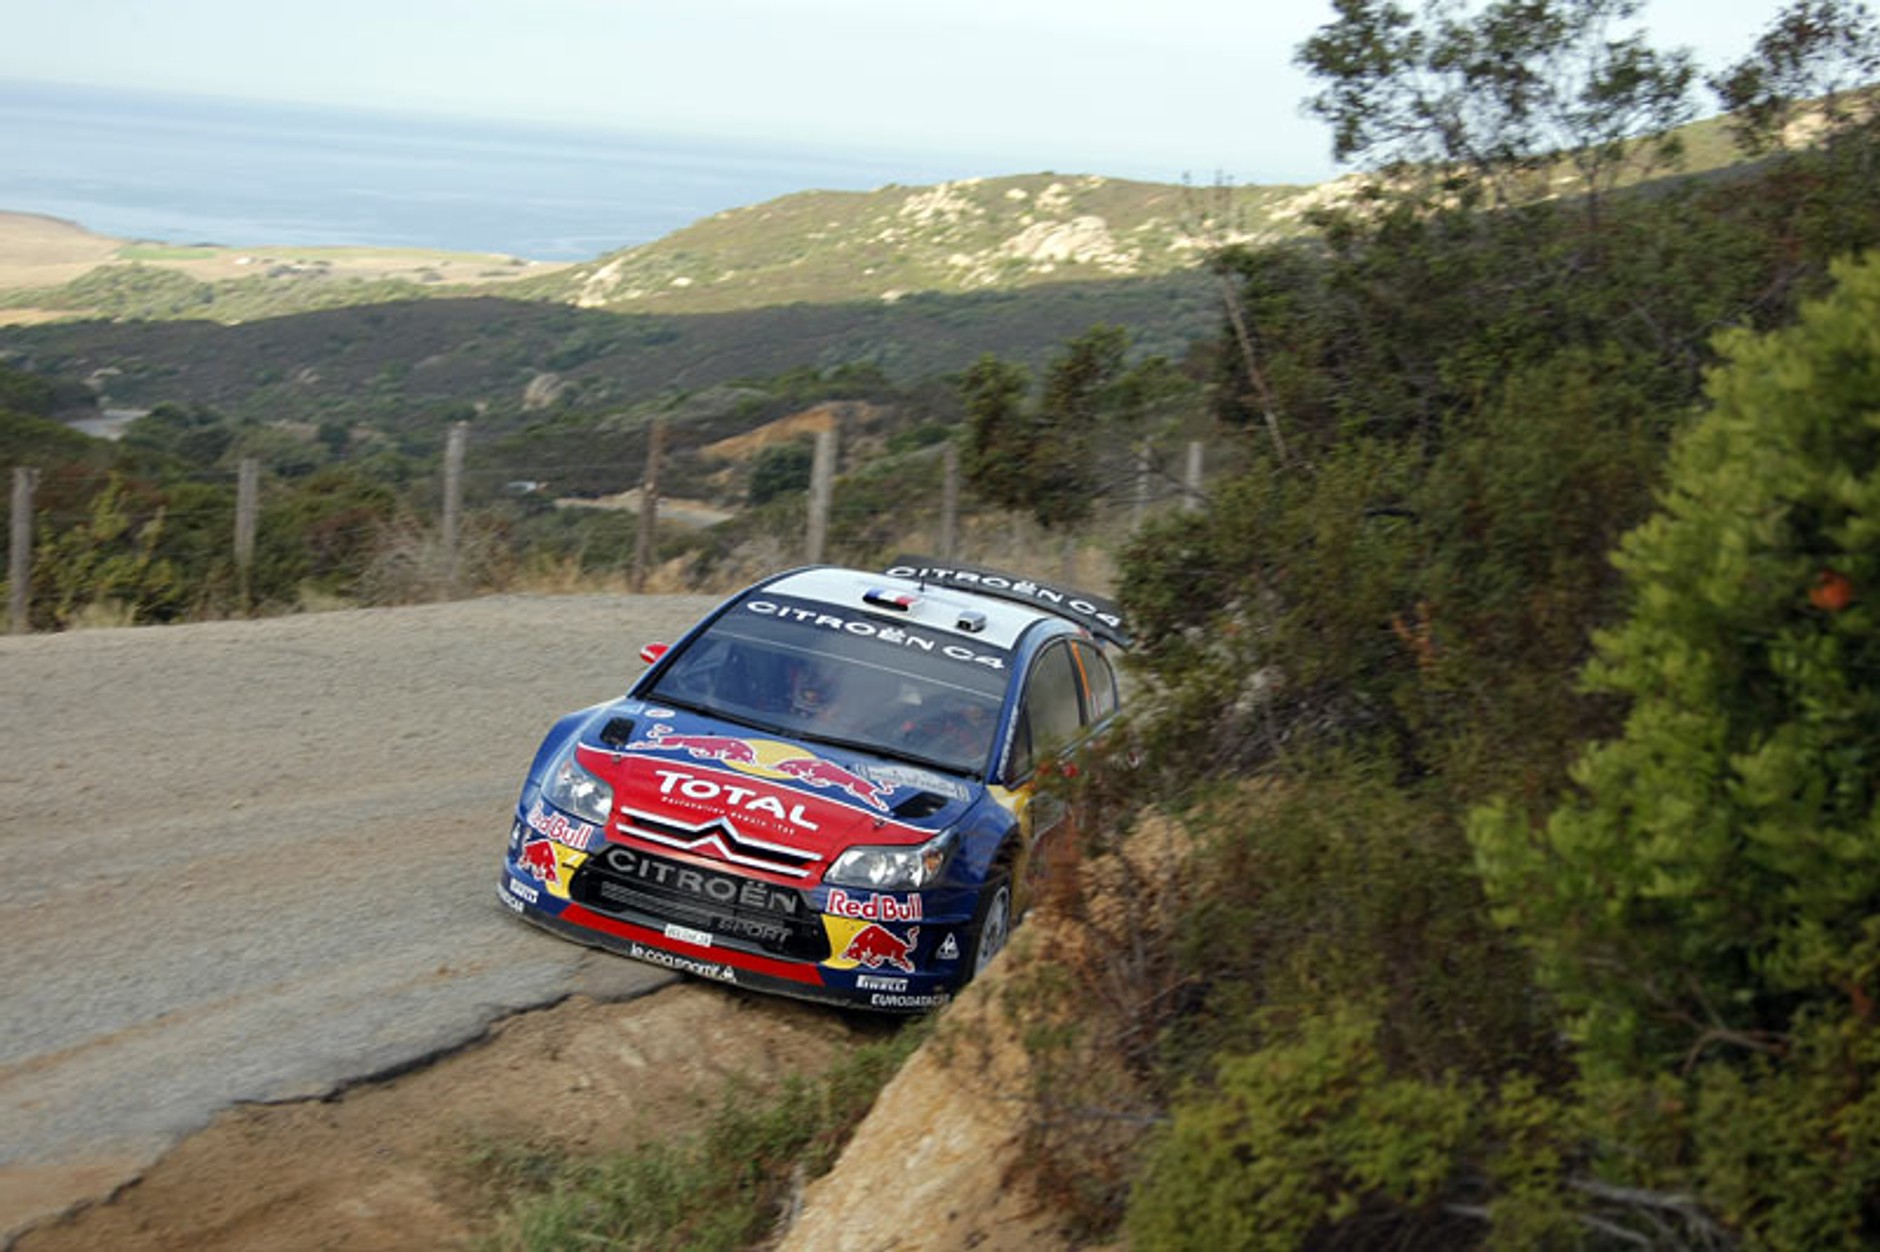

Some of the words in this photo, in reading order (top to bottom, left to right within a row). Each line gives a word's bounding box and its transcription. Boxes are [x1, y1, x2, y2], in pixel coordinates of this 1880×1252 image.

[886, 566, 1064, 603] CITROËN
[1069, 600, 1121, 627] C4
[747, 601, 935, 650] CITROËN
[942, 645, 1005, 669] C4
[655, 769, 819, 831] TOTAL
[549, 812, 594, 851] Bull
[606, 849, 798, 914] CITROËN
[825, 888, 879, 919] Red
[880, 892, 922, 921] Bull
[719, 916, 793, 944] SPORT
[856, 974, 909, 992] PIRELLI
